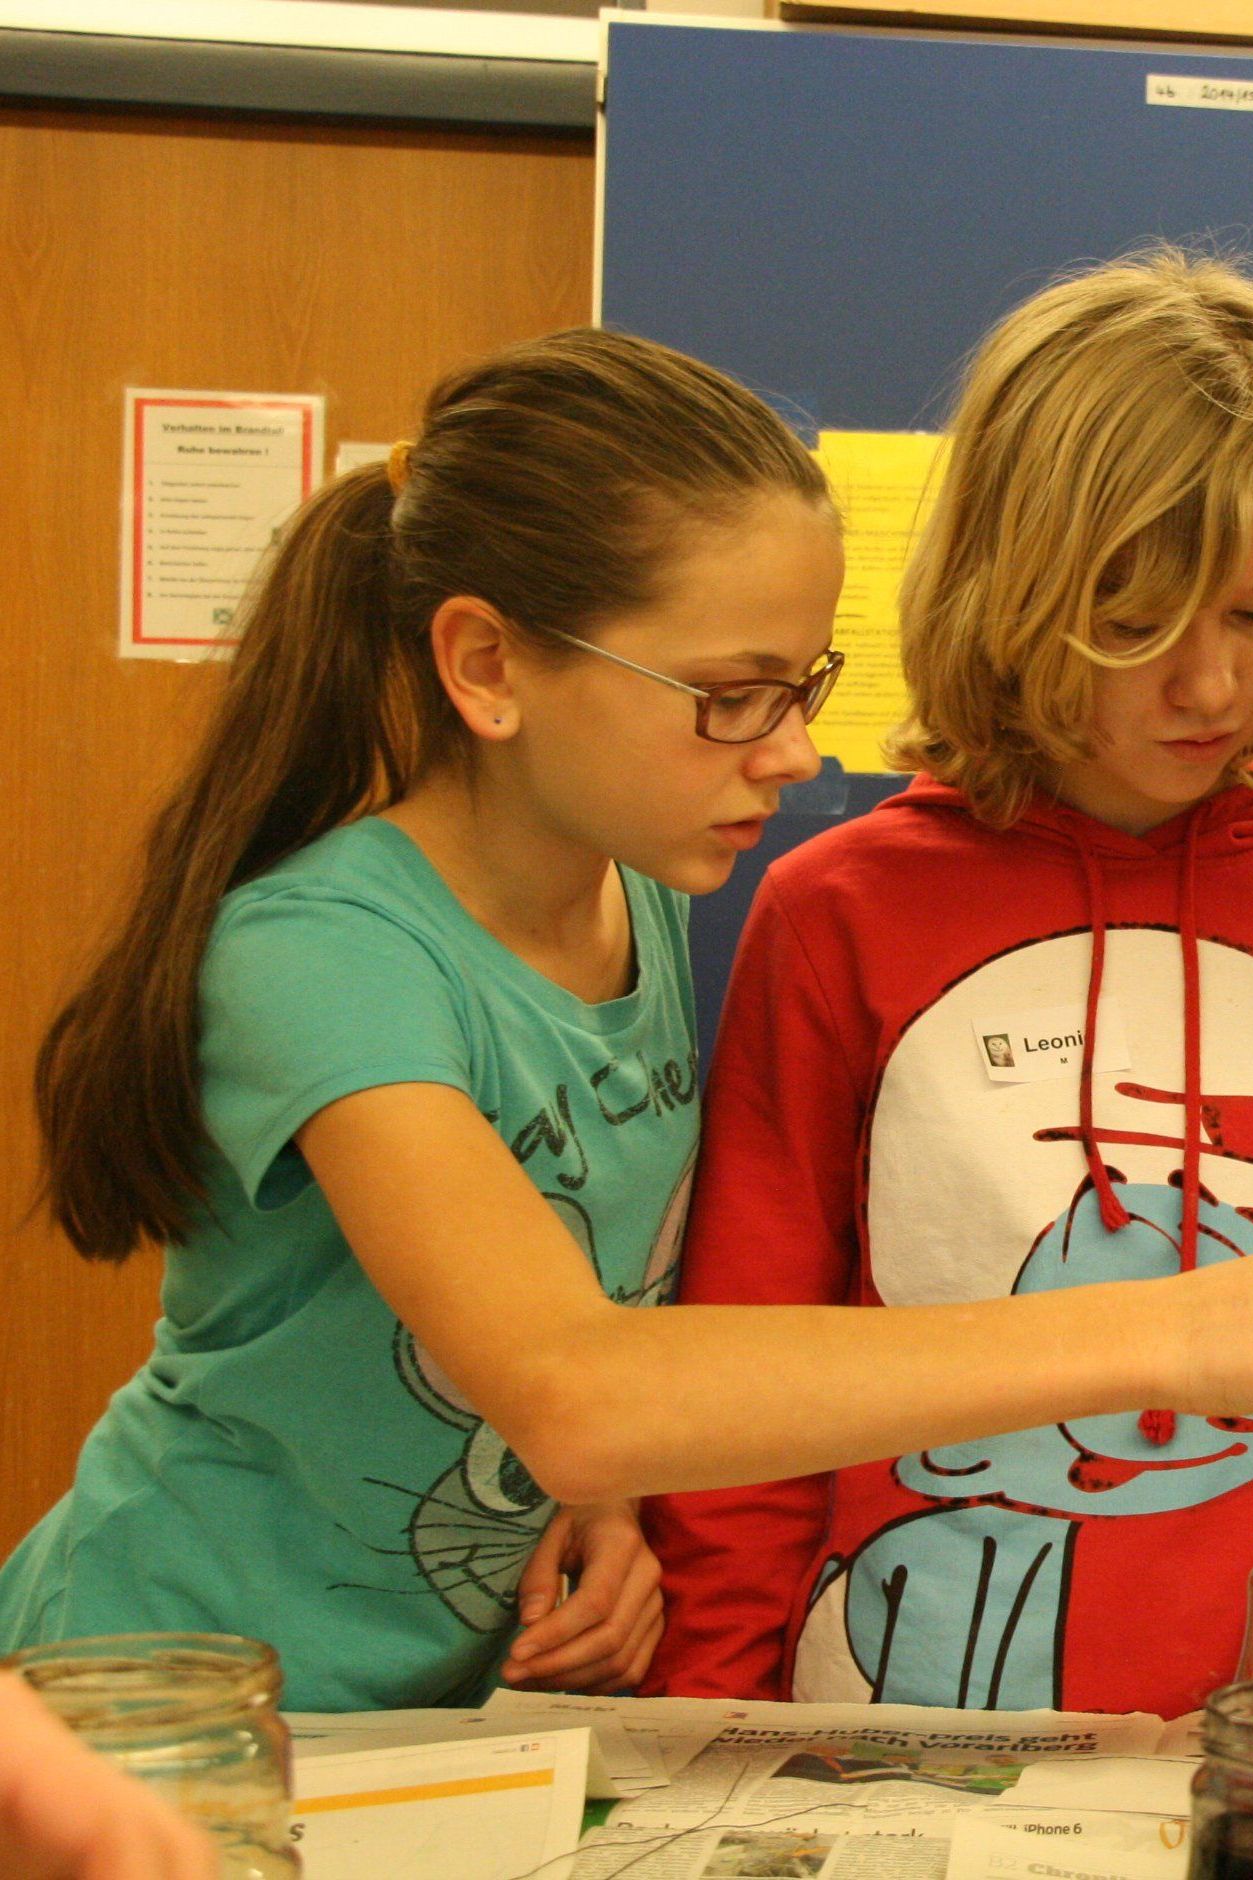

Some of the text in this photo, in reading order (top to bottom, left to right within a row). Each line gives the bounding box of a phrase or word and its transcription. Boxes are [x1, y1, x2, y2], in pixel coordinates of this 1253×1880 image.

[1018, 1732, 1098, 1744] geht
[1023, 1823, 1070, 1836] iPhone
[1073, 1822, 1083, 1835] 6
